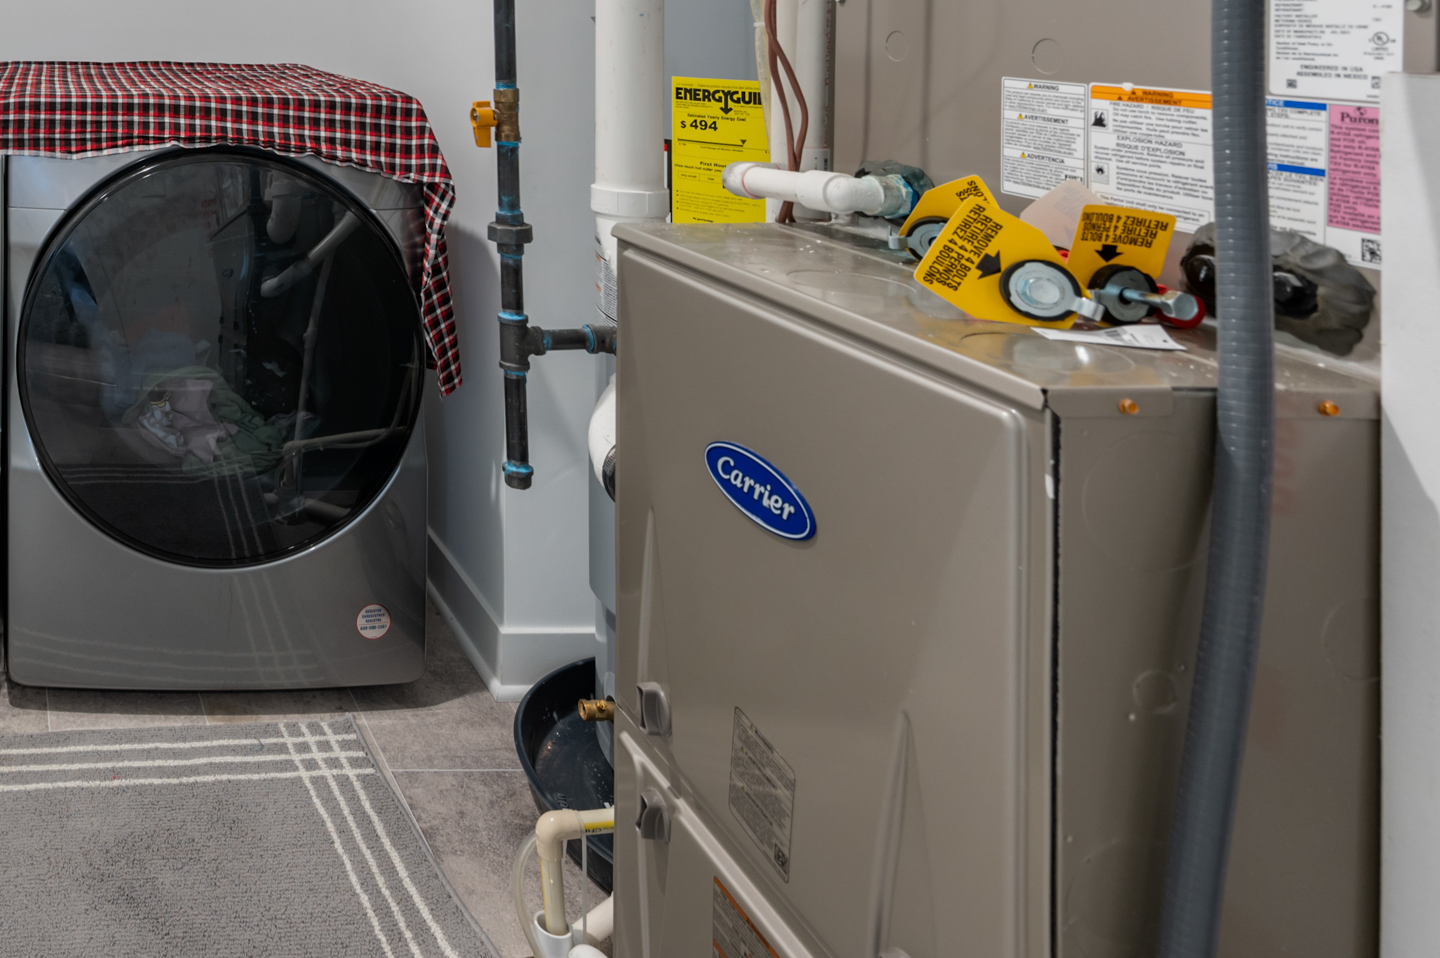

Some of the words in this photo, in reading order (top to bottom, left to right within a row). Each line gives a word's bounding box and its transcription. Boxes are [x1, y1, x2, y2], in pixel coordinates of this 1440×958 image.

[675, 87, 762, 114] ENERGYGUI
[1127, 96, 1182, 106] AVERTISSEMENT
[690, 119, 718, 131] 494
[1024, 115, 1069, 124] AVERTISSEMENT
[1340, 112, 1379, 125] Puron
[1117, 136, 1153, 144] EXPLOSION
[1155, 140, 1183, 148] HAZARD
[1116, 143, 1138, 151] RISQUE
[1141, 145, 1185, 156] D'EXPLOSION
[1027, 154, 1065, 164] ADVERTENCIA
[952, 204, 986, 238] RETIREZ
[1082, 212, 1114, 222] BOULONS
[1124, 215, 1169, 231] RETIREZ
[962, 215, 993, 245] RETIRE
[1081, 231, 1102, 242] BOLTS
[1121, 225, 1158, 239] RETIRE
[947, 238, 958, 246] 4
[975, 222, 1003, 259] REMOVE
[1105, 234, 1110, 242] 4
[1111, 234, 1153, 248] REMOVE
[958, 244, 968, 252] 4
[923, 244, 951, 284] BOULONS
[964, 256, 975, 265] 4
[936, 251, 961, 286] PERNOS
[947, 264, 971, 291] BOLTS
[717, 456, 795, 520] Carrier
